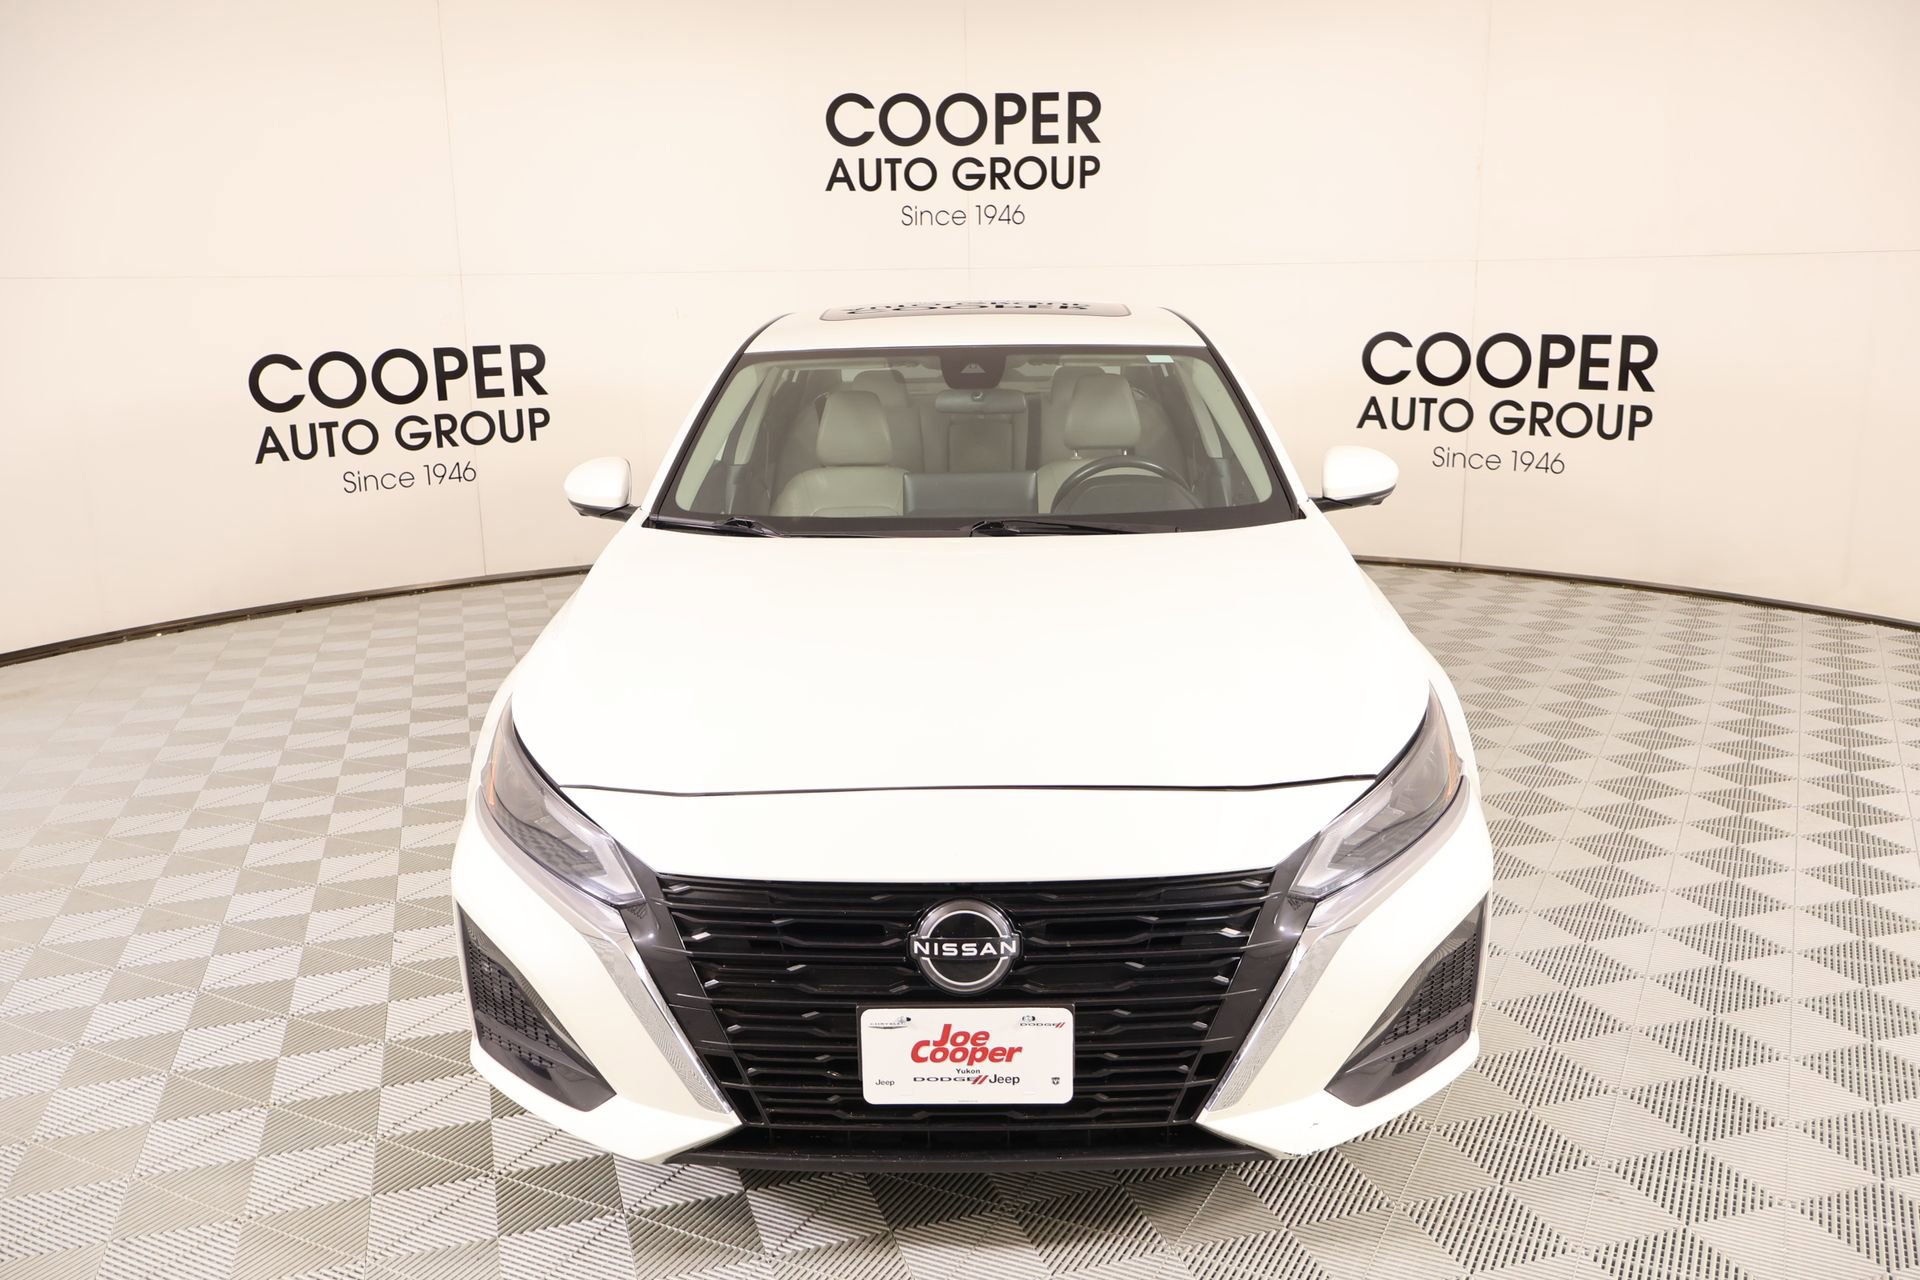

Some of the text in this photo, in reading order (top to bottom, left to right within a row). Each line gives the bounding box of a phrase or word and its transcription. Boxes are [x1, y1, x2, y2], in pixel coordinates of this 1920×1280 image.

[826, 91, 1101, 147] COOPER
[825, 155, 1101, 192] AUTO GROUP
[901, 204, 1026, 226] Since 1946
[1362, 331, 1658, 392] COOPER
[249, 344, 549, 413] COOPER
[1356, 396, 1653, 441] AUTO GROUP
[255, 408, 550, 464] AUTO GROUP
[1432, 446, 1565, 474] Since 1946
[343, 461, 476, 493] Since 1946
[913, 940, 1017, 957] NISSAN
[932, 1023, 990, 1047] Joe
[911, 1040, 1023, 1066] Cooper
[875, 1079, 895, 1087] Jeep
[988, 1074, 1021, 1086] Jeep
